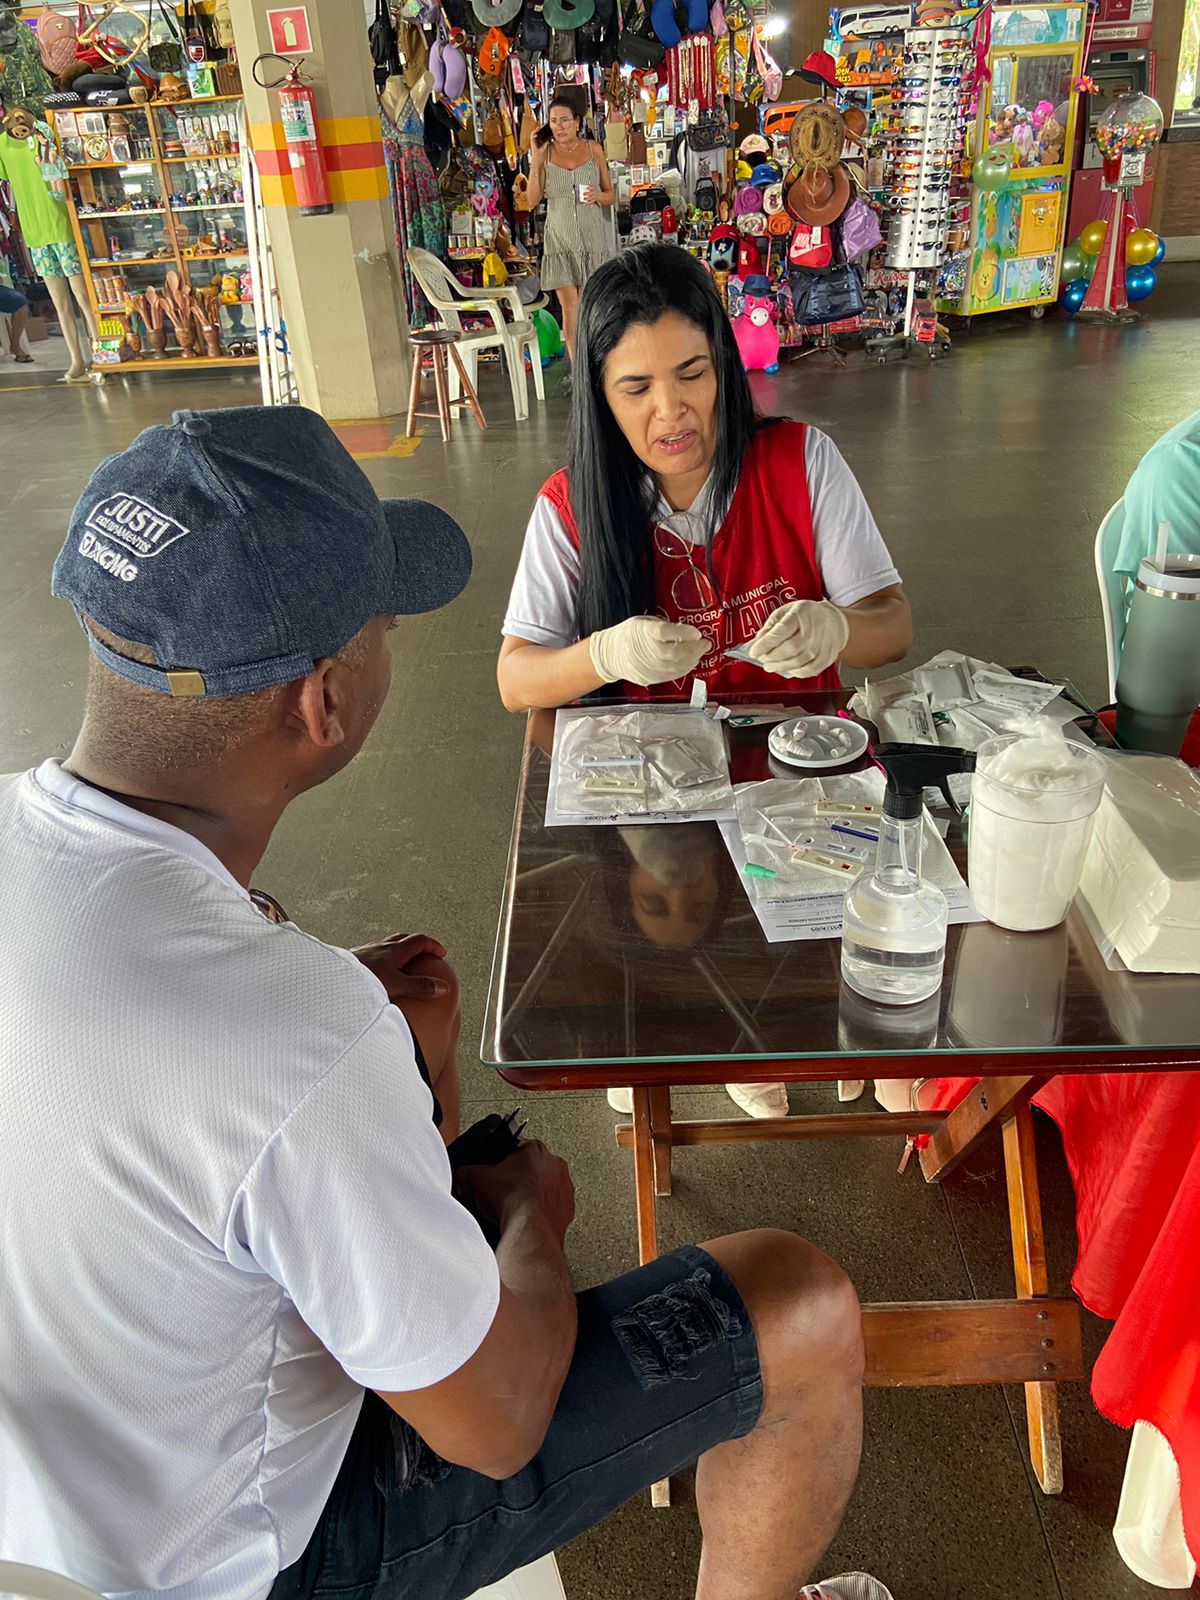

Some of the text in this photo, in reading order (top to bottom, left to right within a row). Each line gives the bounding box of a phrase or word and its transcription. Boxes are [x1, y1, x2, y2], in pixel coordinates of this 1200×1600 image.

[104, 499, 171, 543] JUSTI
[90, 542, 140, 582] XCMG
[678, 576, 789, 625] PROGRAA MUNICIPAL
